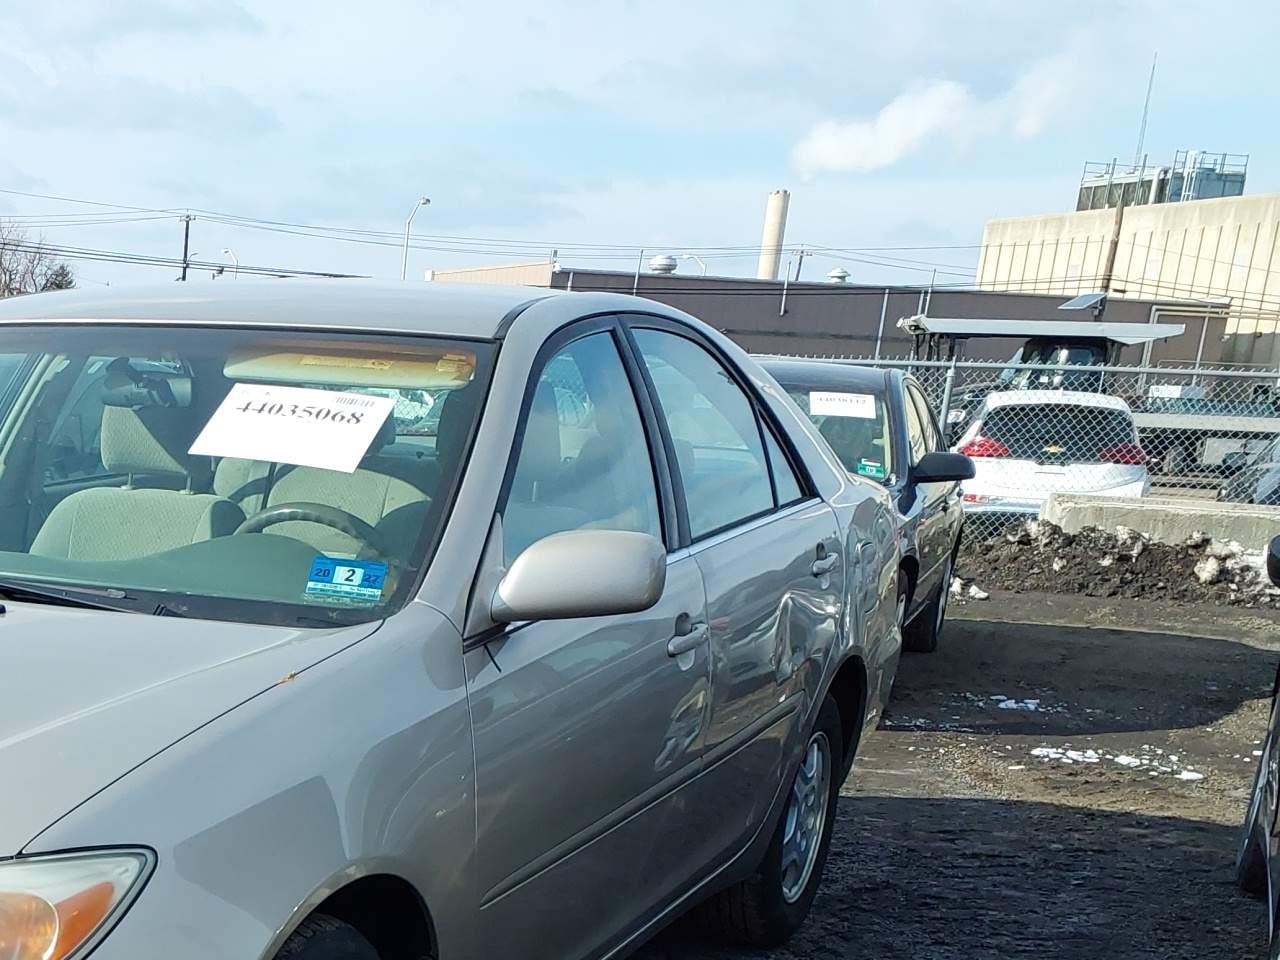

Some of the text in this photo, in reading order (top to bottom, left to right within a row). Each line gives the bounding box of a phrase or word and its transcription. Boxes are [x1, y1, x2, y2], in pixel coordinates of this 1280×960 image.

[236, 401, 365, 424] 44035068
[314, 567, 382, 584] 20 2 27
